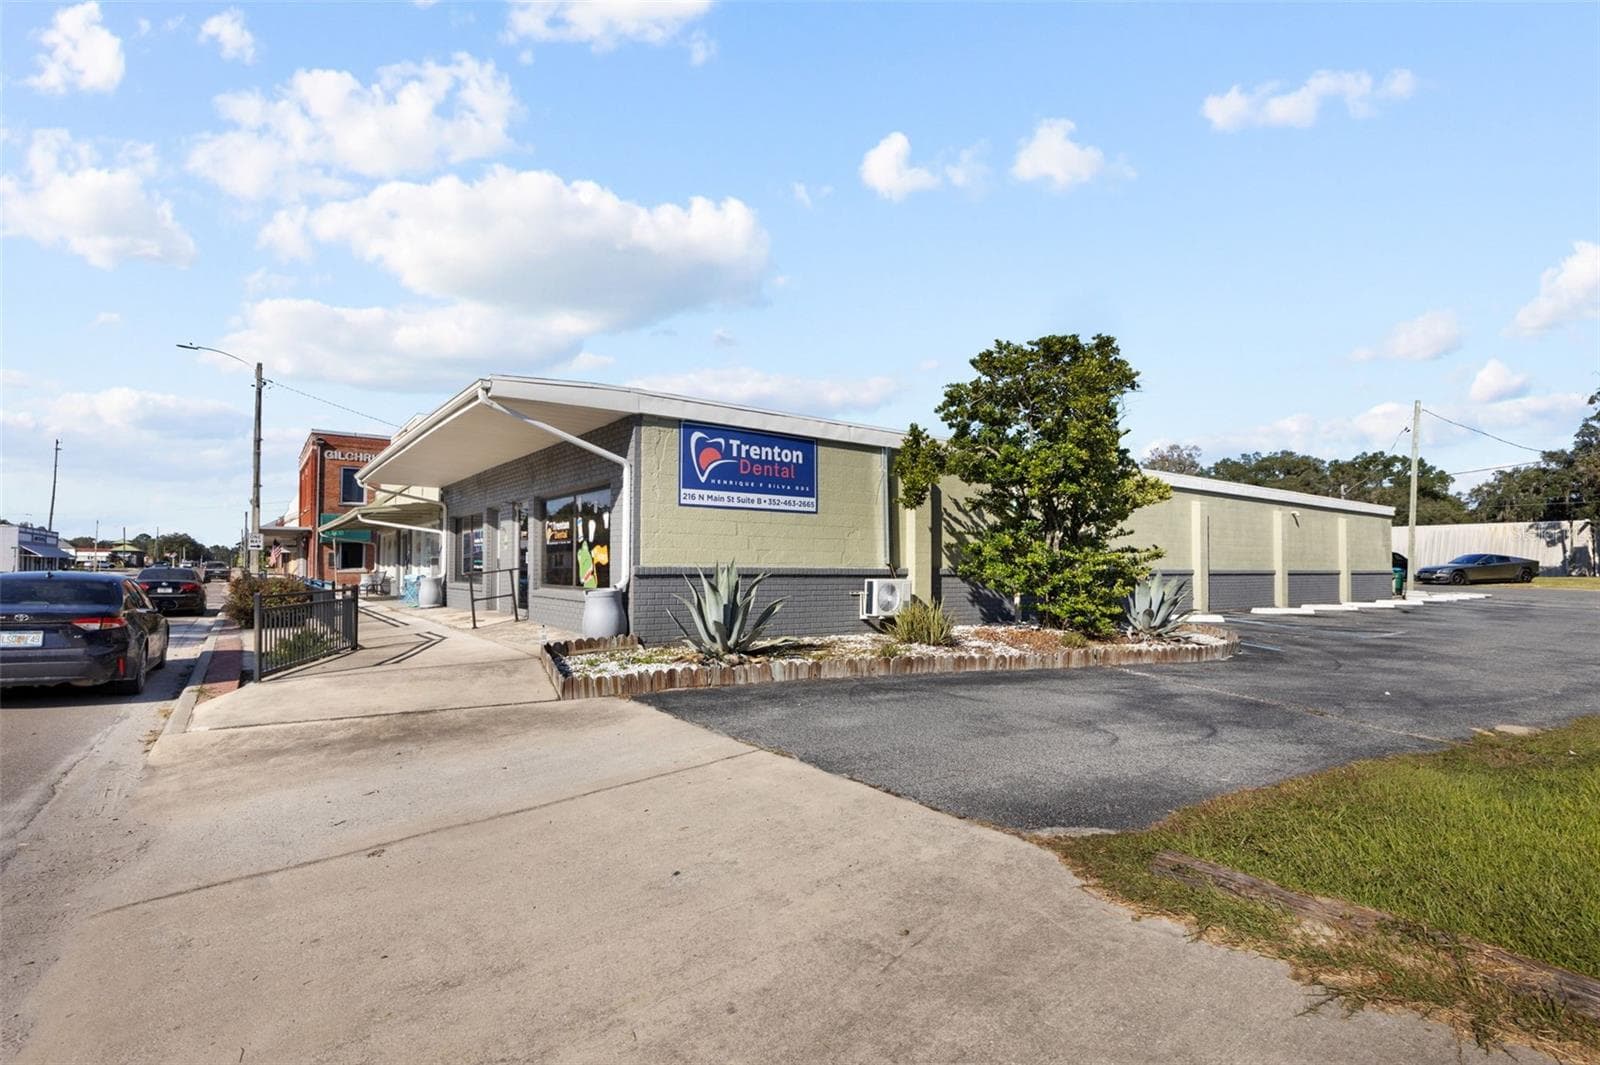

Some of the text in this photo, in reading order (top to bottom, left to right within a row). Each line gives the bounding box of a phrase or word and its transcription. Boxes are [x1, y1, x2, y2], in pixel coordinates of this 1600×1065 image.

[729, 439, 803, 464] Trenton
[739, 458, 795, 479] Dental
[683, 493, 696, 501] 216
[706, 494, 725, 502] Main
[737, 496, 755, 504] Suite
